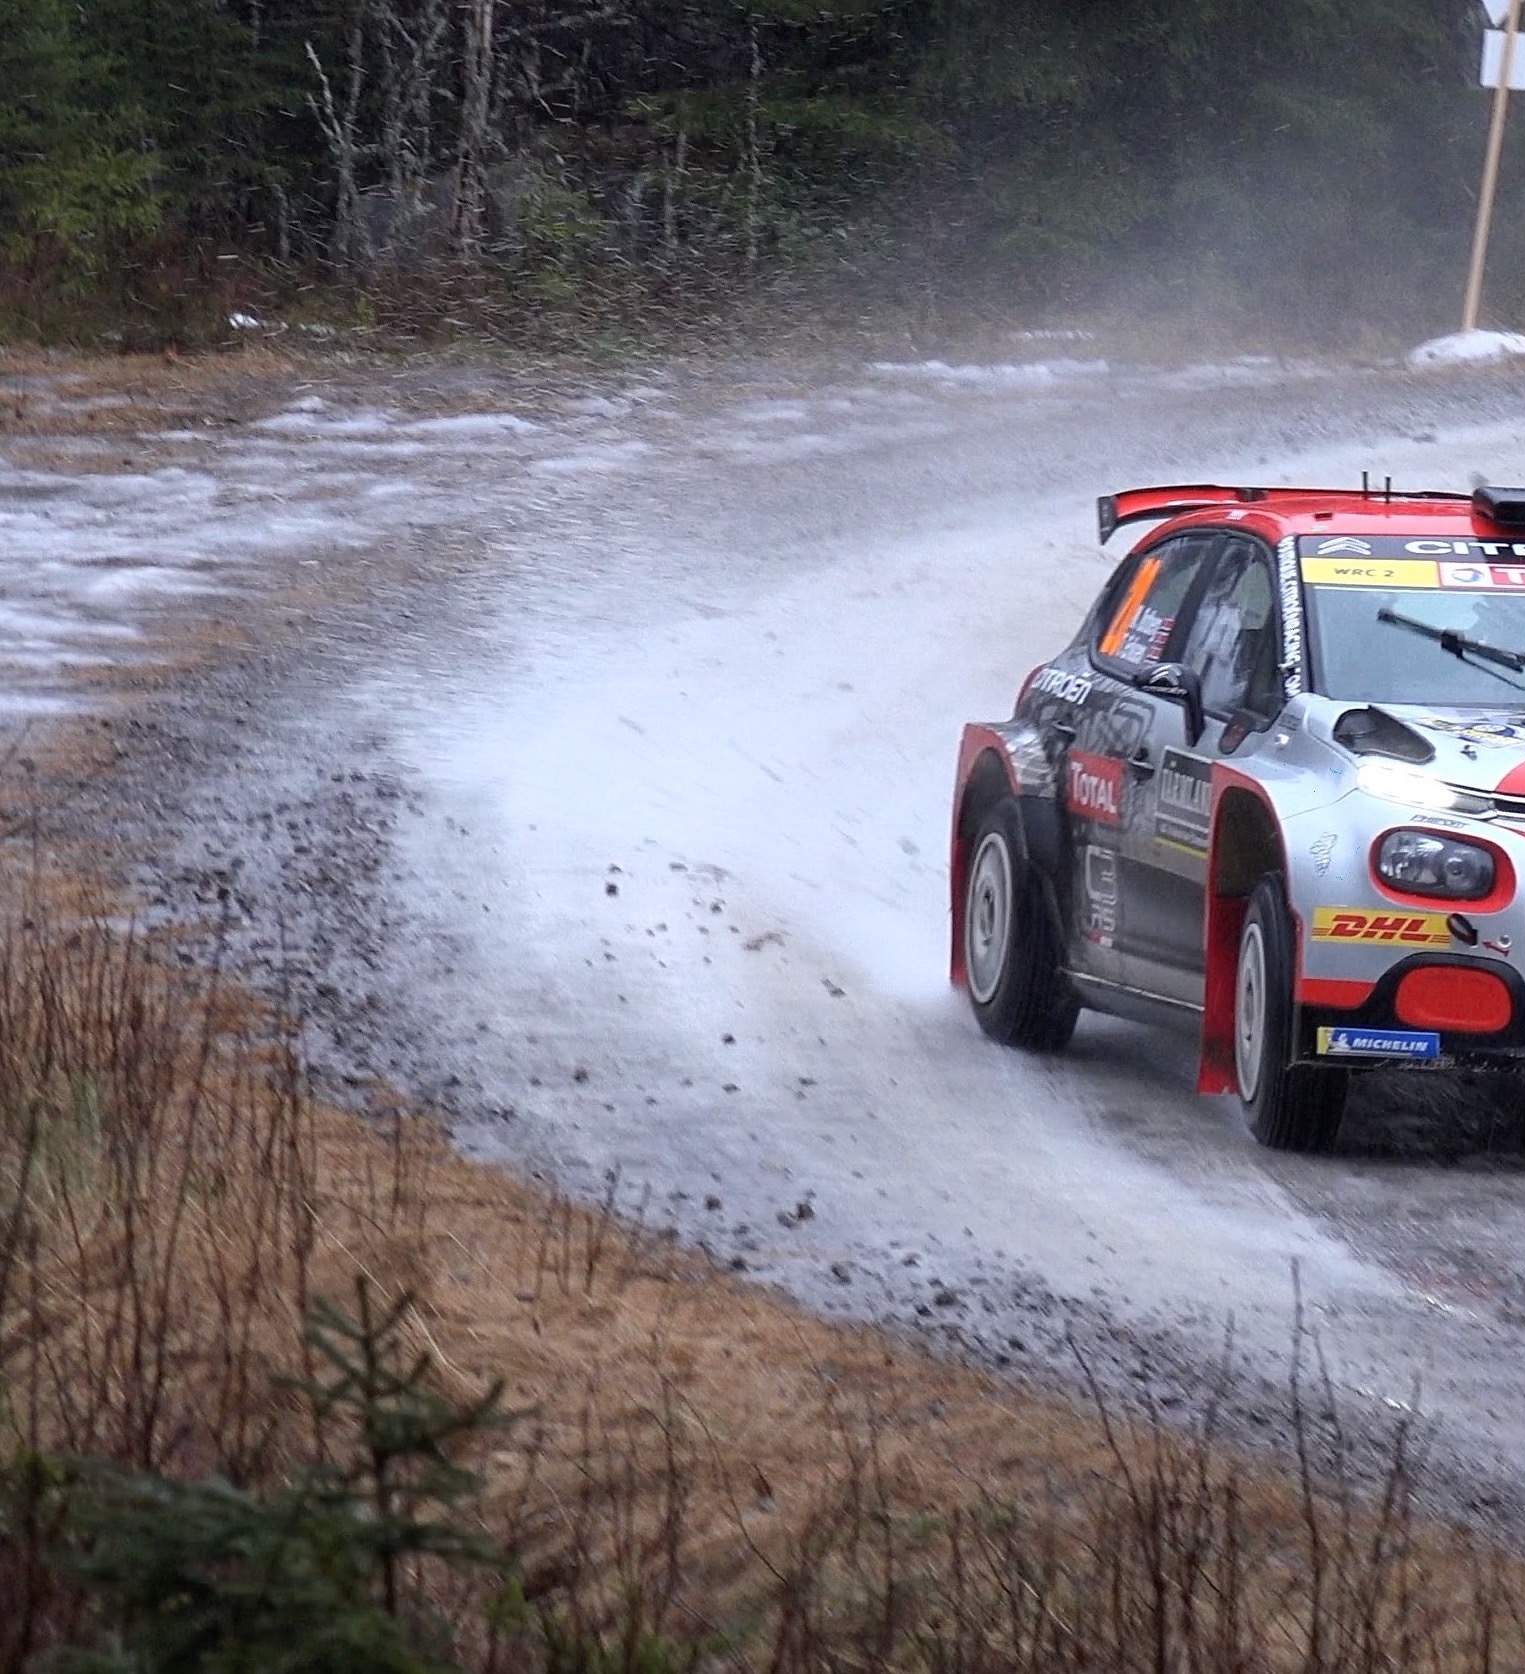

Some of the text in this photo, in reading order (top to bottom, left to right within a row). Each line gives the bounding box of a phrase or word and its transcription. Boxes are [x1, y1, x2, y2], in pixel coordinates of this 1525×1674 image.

[1334, 568, 1376, 577] WRC
[1071, 762, 1117, 813] TOTAL
[1329, 914, 1431, 942] DHL
[1352, 1037, 1429, 1052] MICHELIN
